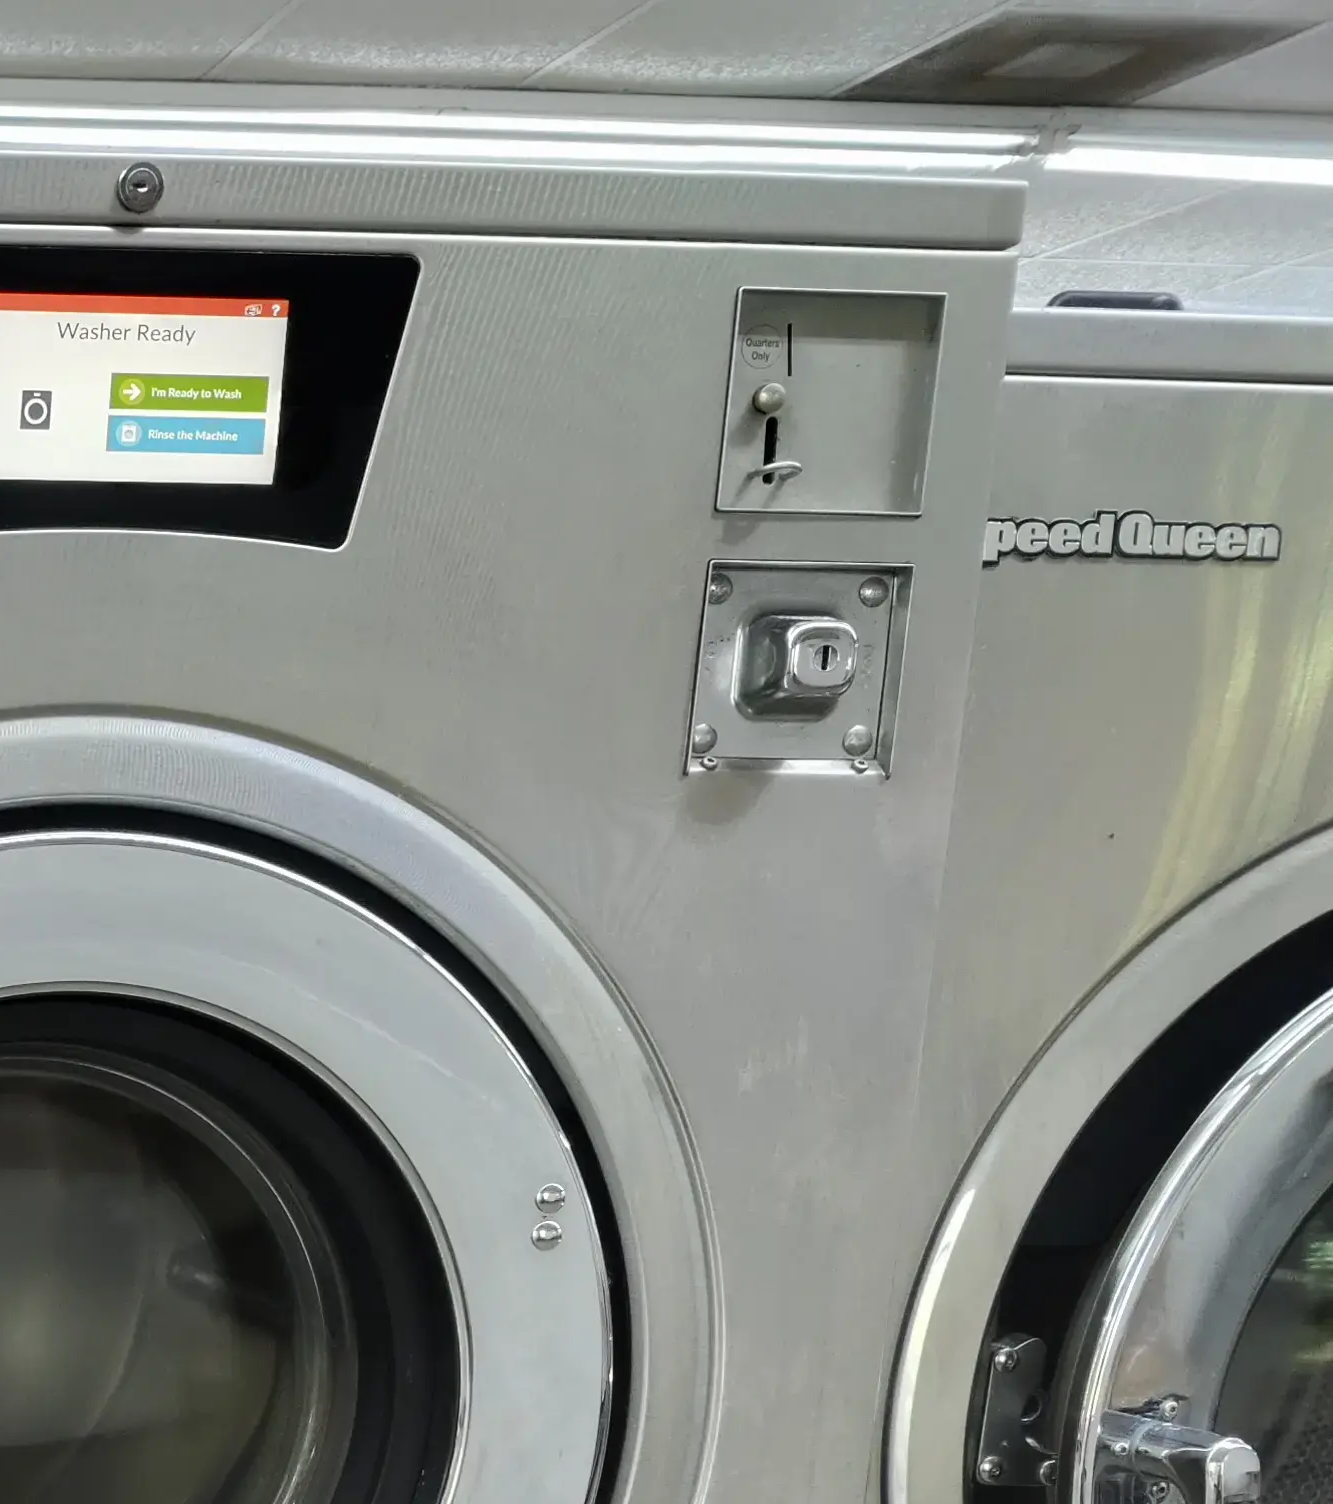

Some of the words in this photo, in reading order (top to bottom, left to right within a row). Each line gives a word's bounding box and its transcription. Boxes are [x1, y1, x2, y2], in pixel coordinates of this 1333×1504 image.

[272, 304, 281, 316] ?
[57, 322, 131, 340] Washer
[137, 324, 196, 346] Ready
[745, 338, 780, 348] Quarters
[751, 351, 770, 363] Only
[151, 387, 166, 397] I'm
[168, 387, 199, 400] Ready
[201, 388, 212, 398] to
[213, 388, 242, 399] Wash
[148, 429, 175, 440] Rinse
[177, 430, 193, 440] the
[195, 430, 238, 442] Machine
[982, 509, 1117, 570] peed
[1118, 509, 1282, 562] Queen
